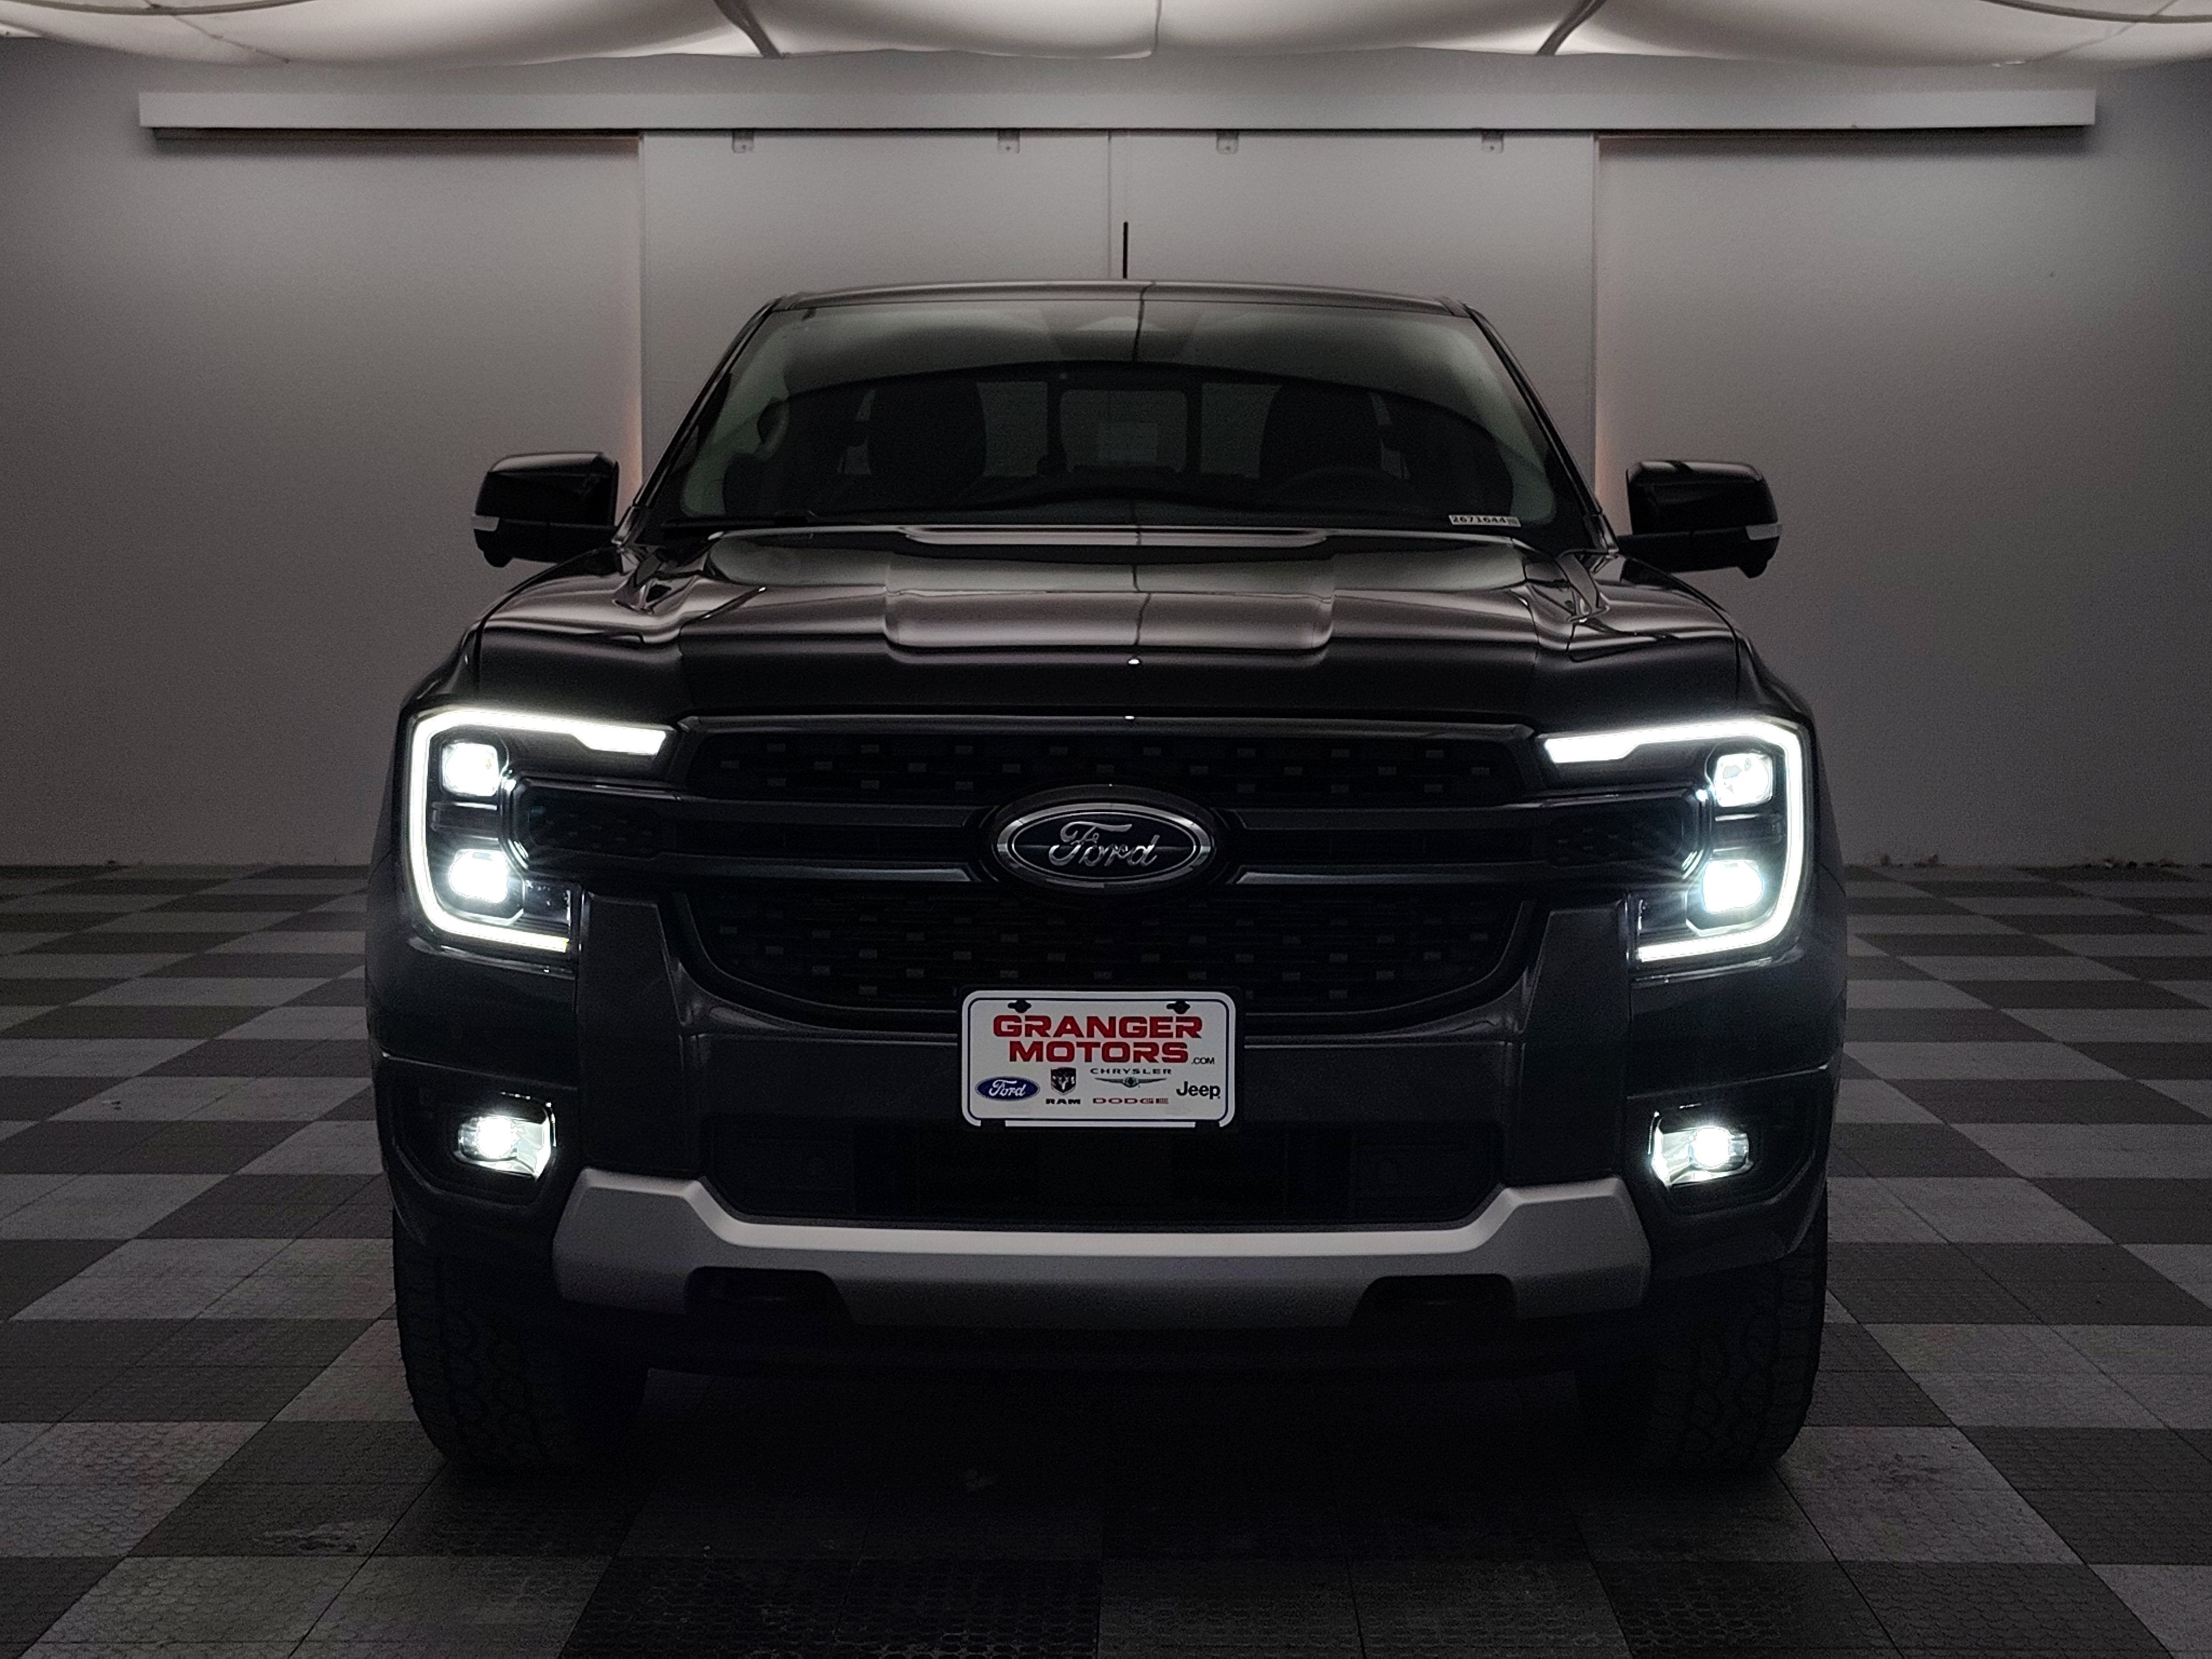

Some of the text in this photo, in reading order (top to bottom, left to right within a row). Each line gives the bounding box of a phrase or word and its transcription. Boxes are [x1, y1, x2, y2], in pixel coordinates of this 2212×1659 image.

[1049, 821, 1159, 866] Ford
[993, 1015, 1203, 1038] GRANGER
[1009, 1042, 1189, 1063] MOTORS
[988, 1080, 1027, 1097] Ford
[1176, 1081, 1220, 1100] Jeep
